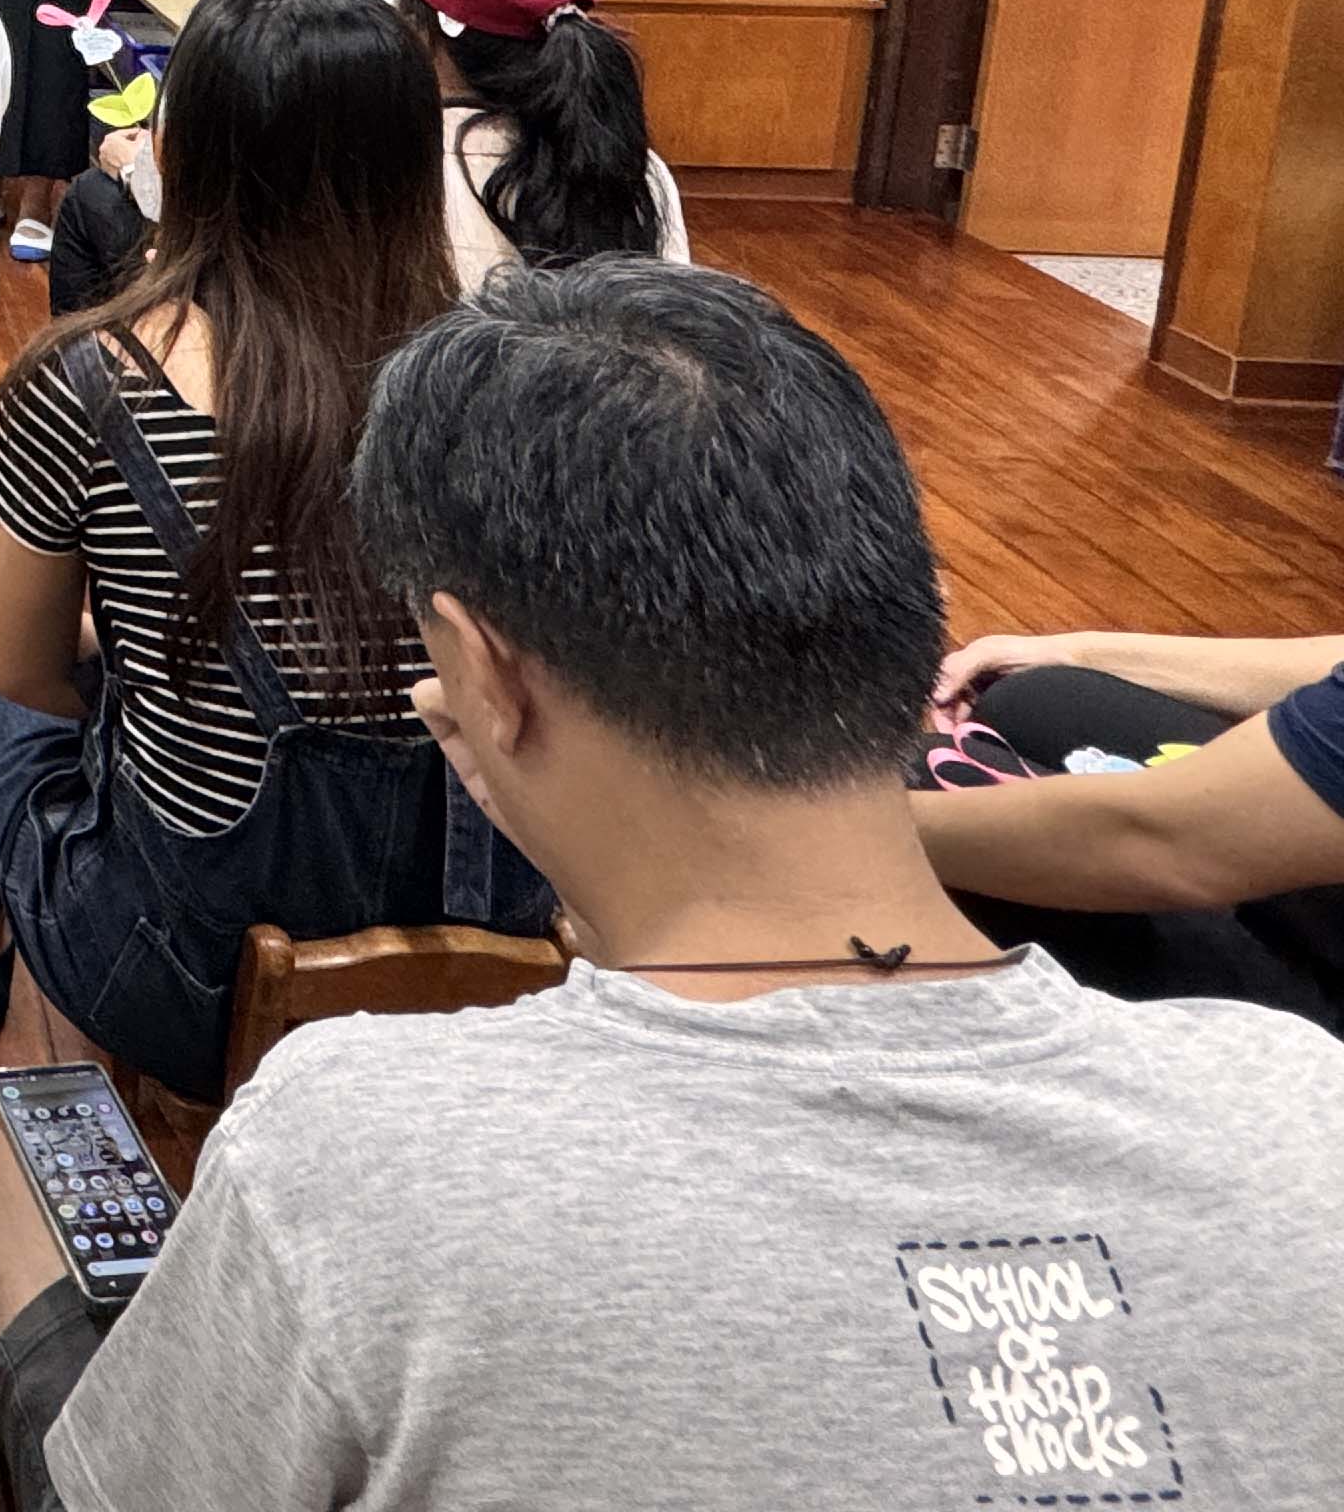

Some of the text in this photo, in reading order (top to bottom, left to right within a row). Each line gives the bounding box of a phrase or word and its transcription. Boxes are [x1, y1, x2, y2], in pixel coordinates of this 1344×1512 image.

[918, 1259, 1114, 1332] SCHOOL
[998, 1322, 1059, 1372] OF
[968, 1365, 1111, 1424] HARD
